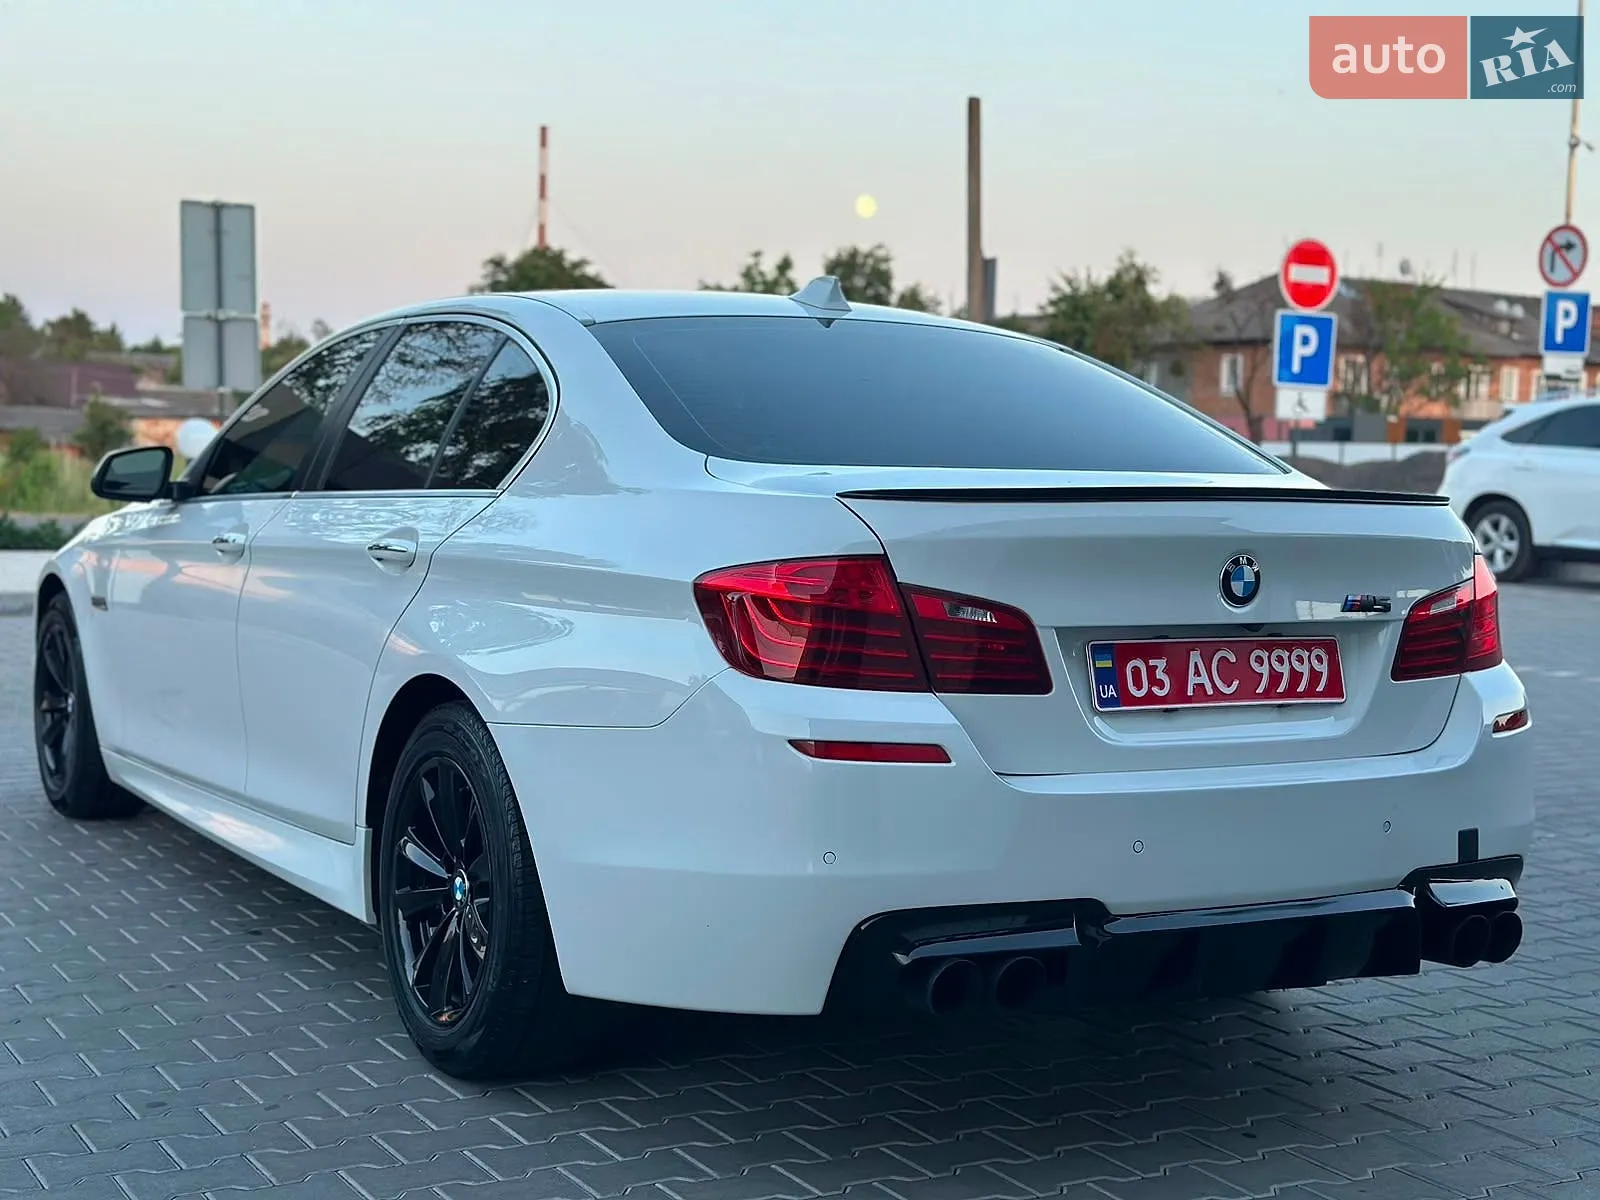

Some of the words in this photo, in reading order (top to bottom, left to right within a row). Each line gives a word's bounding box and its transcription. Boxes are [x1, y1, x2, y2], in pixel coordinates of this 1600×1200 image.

[1554, 300, 1579, 344] P
[1291, 324, 1319, 374] P
[1226, 556, 1260, 573] BMW
[1100, 684, 1118, 700] UA
[1126, 657, 1171, 698] 03
[1187, 648, 1240, 697] AC
[1250, 648, 1329, 694] 9999
